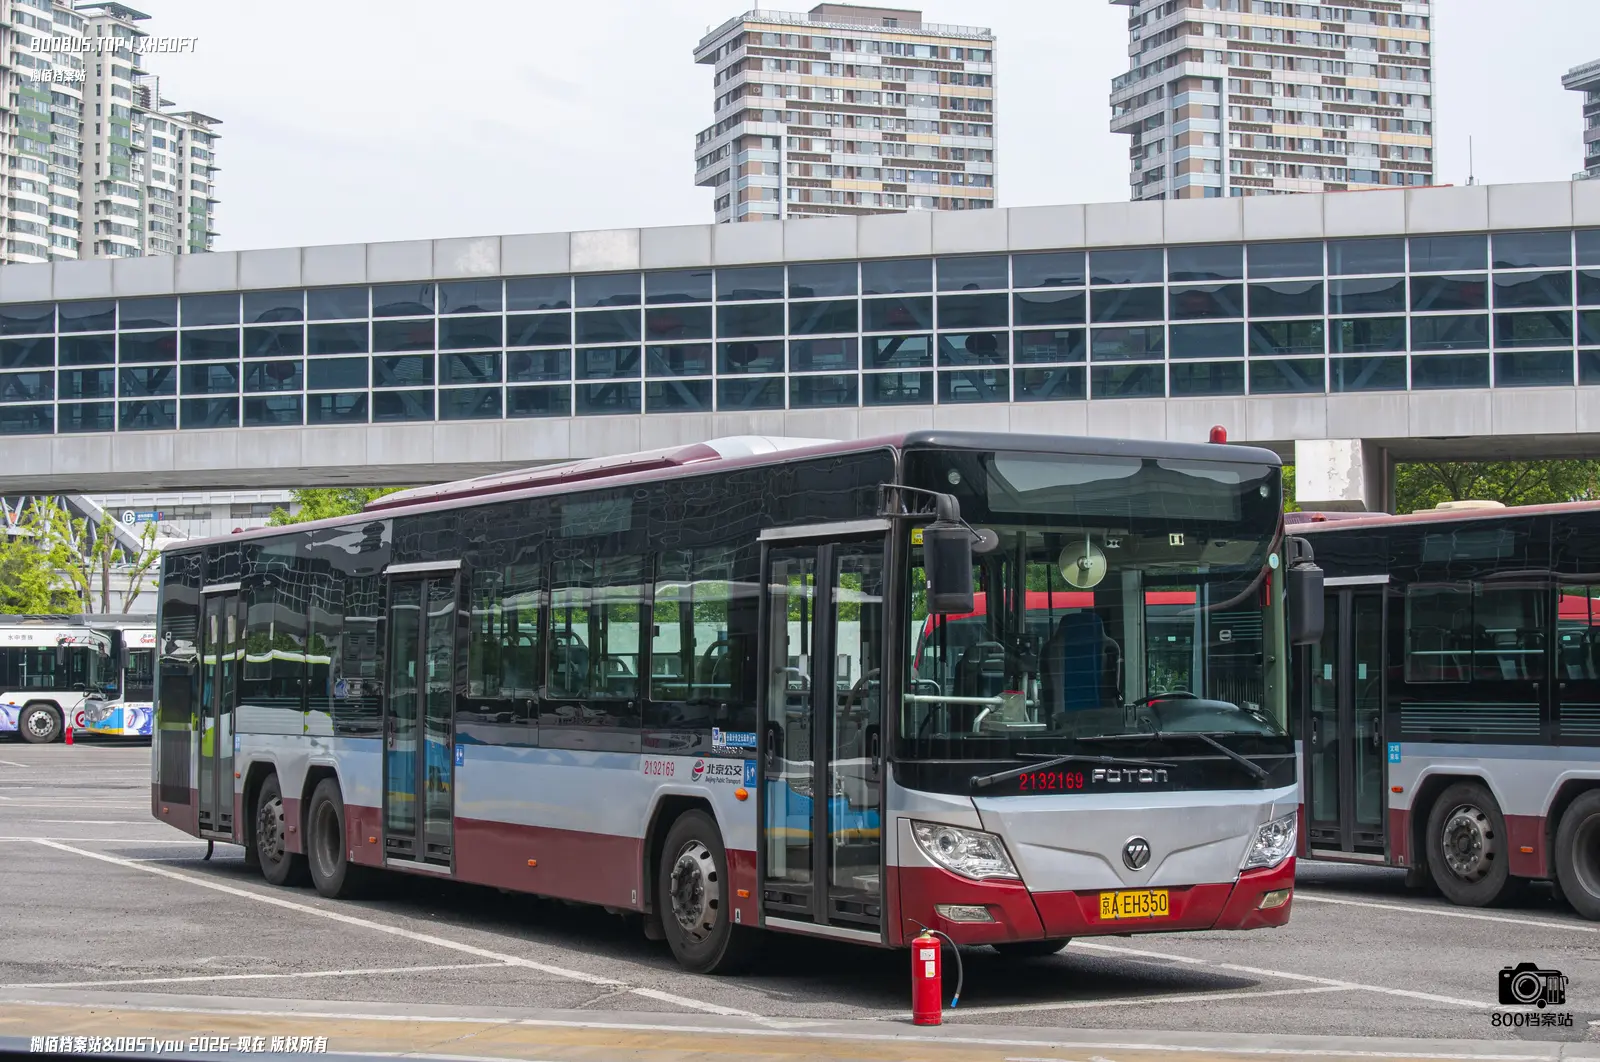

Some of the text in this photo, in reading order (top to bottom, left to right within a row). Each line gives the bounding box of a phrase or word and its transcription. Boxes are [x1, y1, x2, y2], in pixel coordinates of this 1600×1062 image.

[644, 760, 675, 777] 2132169
[706, 763, 743, 777] 北京公交
[705, 776, 741, 785] Beijing Public Transport
[1019, 771, 1084, 790] 2132169
